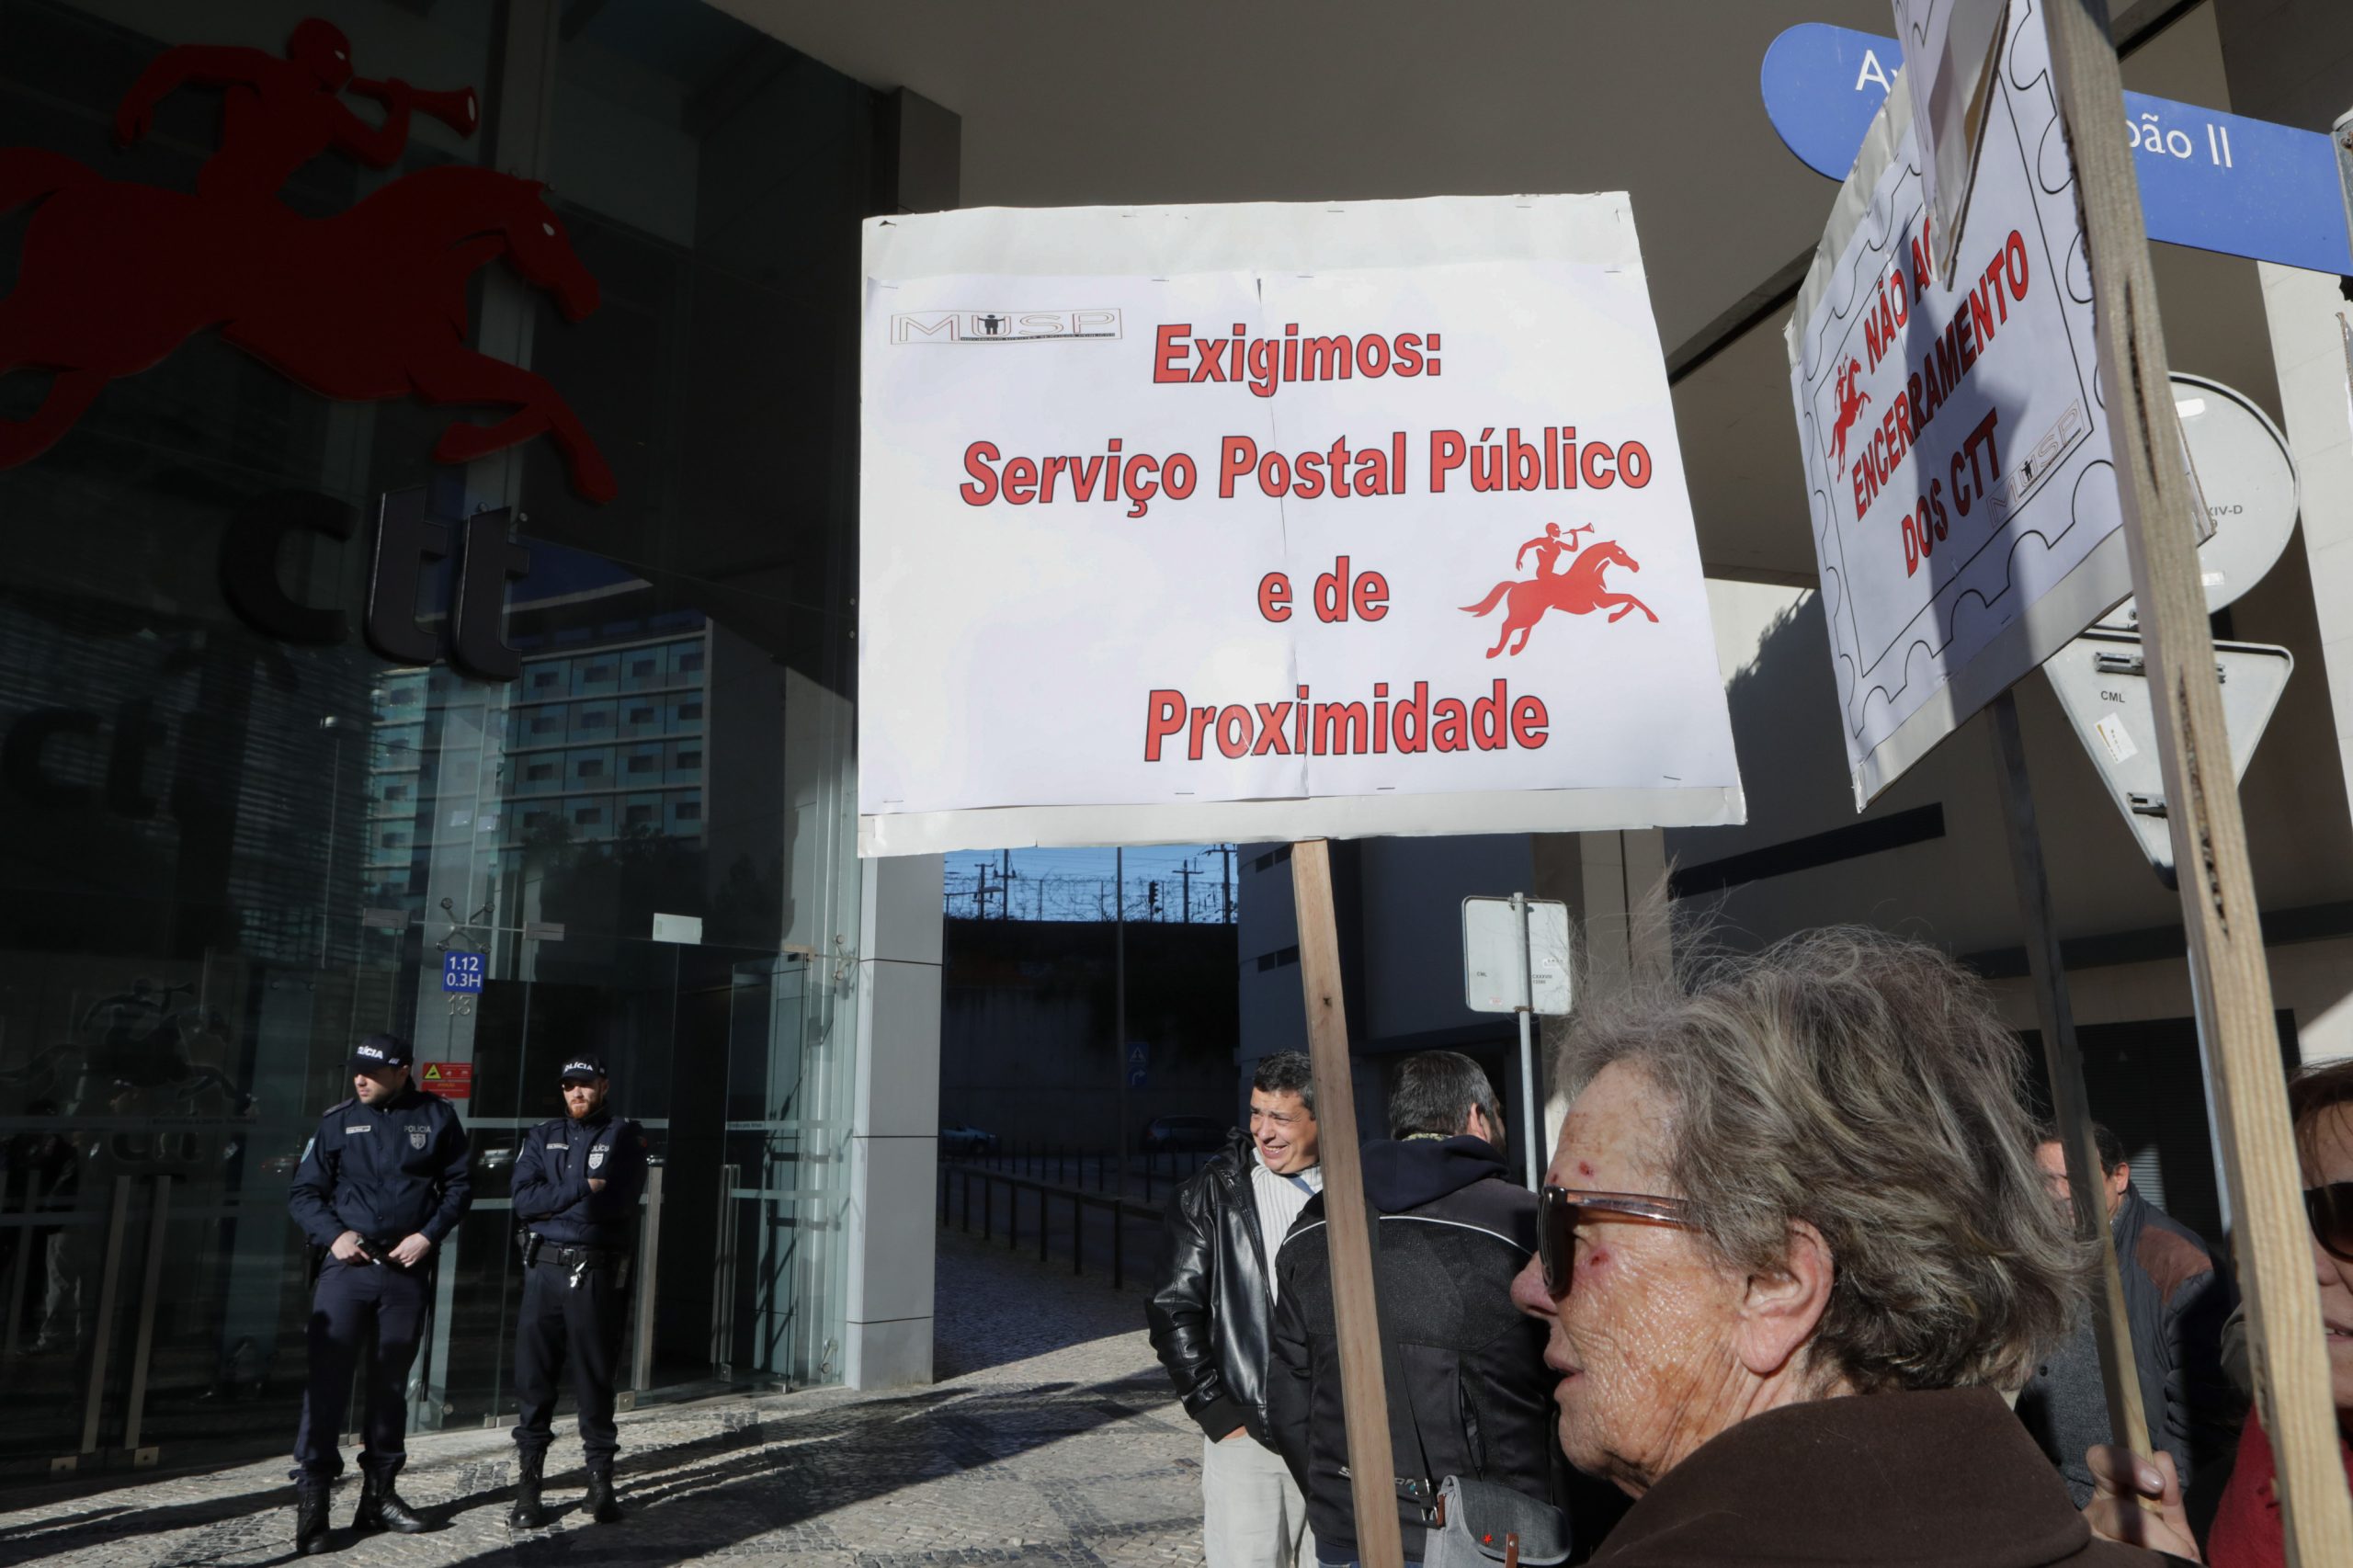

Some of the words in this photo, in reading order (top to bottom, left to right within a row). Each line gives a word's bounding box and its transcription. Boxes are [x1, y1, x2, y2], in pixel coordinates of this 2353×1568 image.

[1855, 49, 1898, 95] A
[2124, 112, 2192, 159] oão
[2206, 123, 2233, 168] II
[899, 312, 1116, 342] MUSP
[1153, 322, 1442, 398] Exigimos:
[1864, 268, 1908, 376] NÃO
[1851, 230, 2029, 522] ENCERRAMENTO
[960, 437, 1198, 519] Serviço
[1218, 430, 1407, 500] Postal
[1428, 426, 1654, 494] Público
[1901, 478, 1949, 578] DOS
[1950, 406, 2001, 517] CTT
[219, 485, 530, 682] ctt
[1256, 571, 1293, 623] e
[1313, 555, 1390, 624] de
[1143, 677, 1550, 762] Proximidade
[2100, 690, 2125, 703] CML
[446, 972, 482, 988] 0.3H
[449, 956, 479, 971] 1.12
[404, 1124, 432, 1134] POLÍCIA
